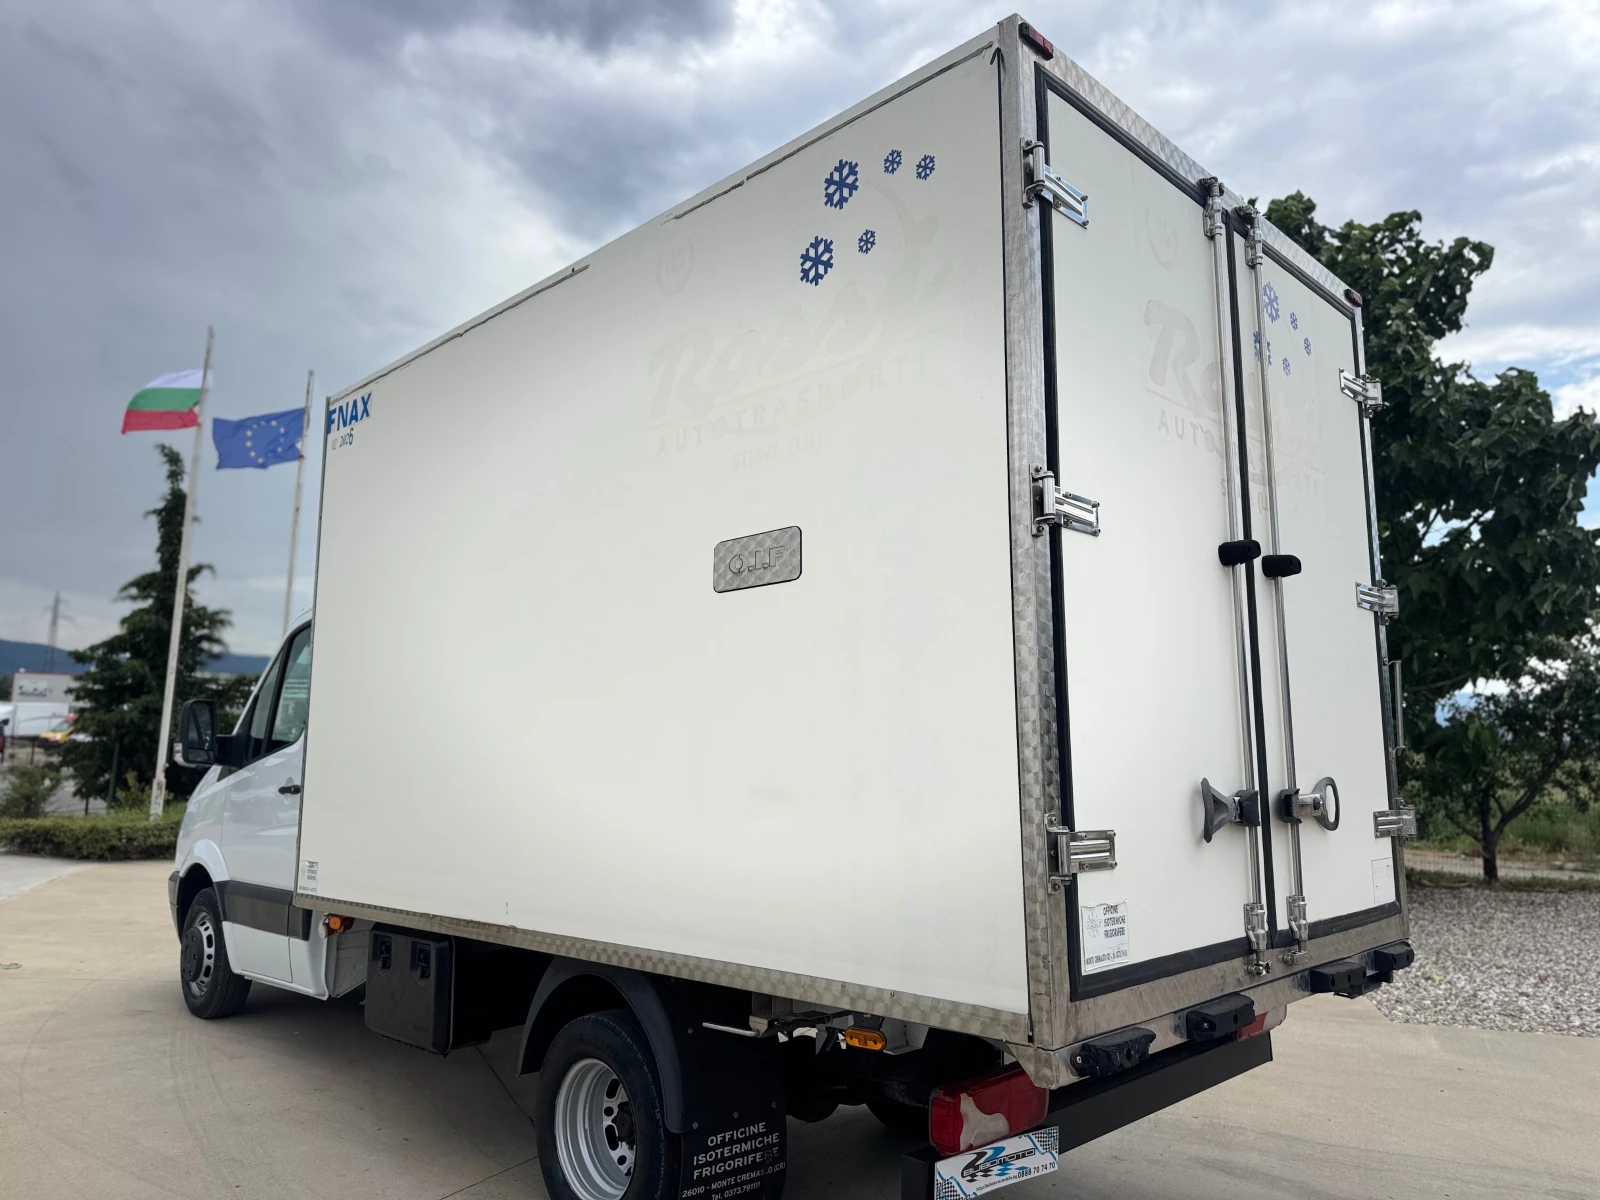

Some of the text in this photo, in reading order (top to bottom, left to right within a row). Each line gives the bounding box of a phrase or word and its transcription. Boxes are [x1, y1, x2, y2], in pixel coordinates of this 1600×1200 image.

[327, 392, 371, 435] FNAX
[693, 1133, 780, 1166] ISOTERMICHE
[707, 1122, 767, 1147] OFFICINE
[693, 1147, 780, 1180] FRIGORIFERE
[963, 1149, 1035, 1177] BUBOMOTO
[1017, 1168, 1032, 1179] 0888
[1033, 1166, 1040, 1175] 70
[1041, 1163, 1048, 1172] 74
[1049, 1162, 1056, 1170] 70
[682, 1186, 705, 1198] 26010
[711, 1176, 736, 1190] MONTE
[736, 1166, 773, 1183] CREMASO
[712, 1191, 723, 1200] Tel.
